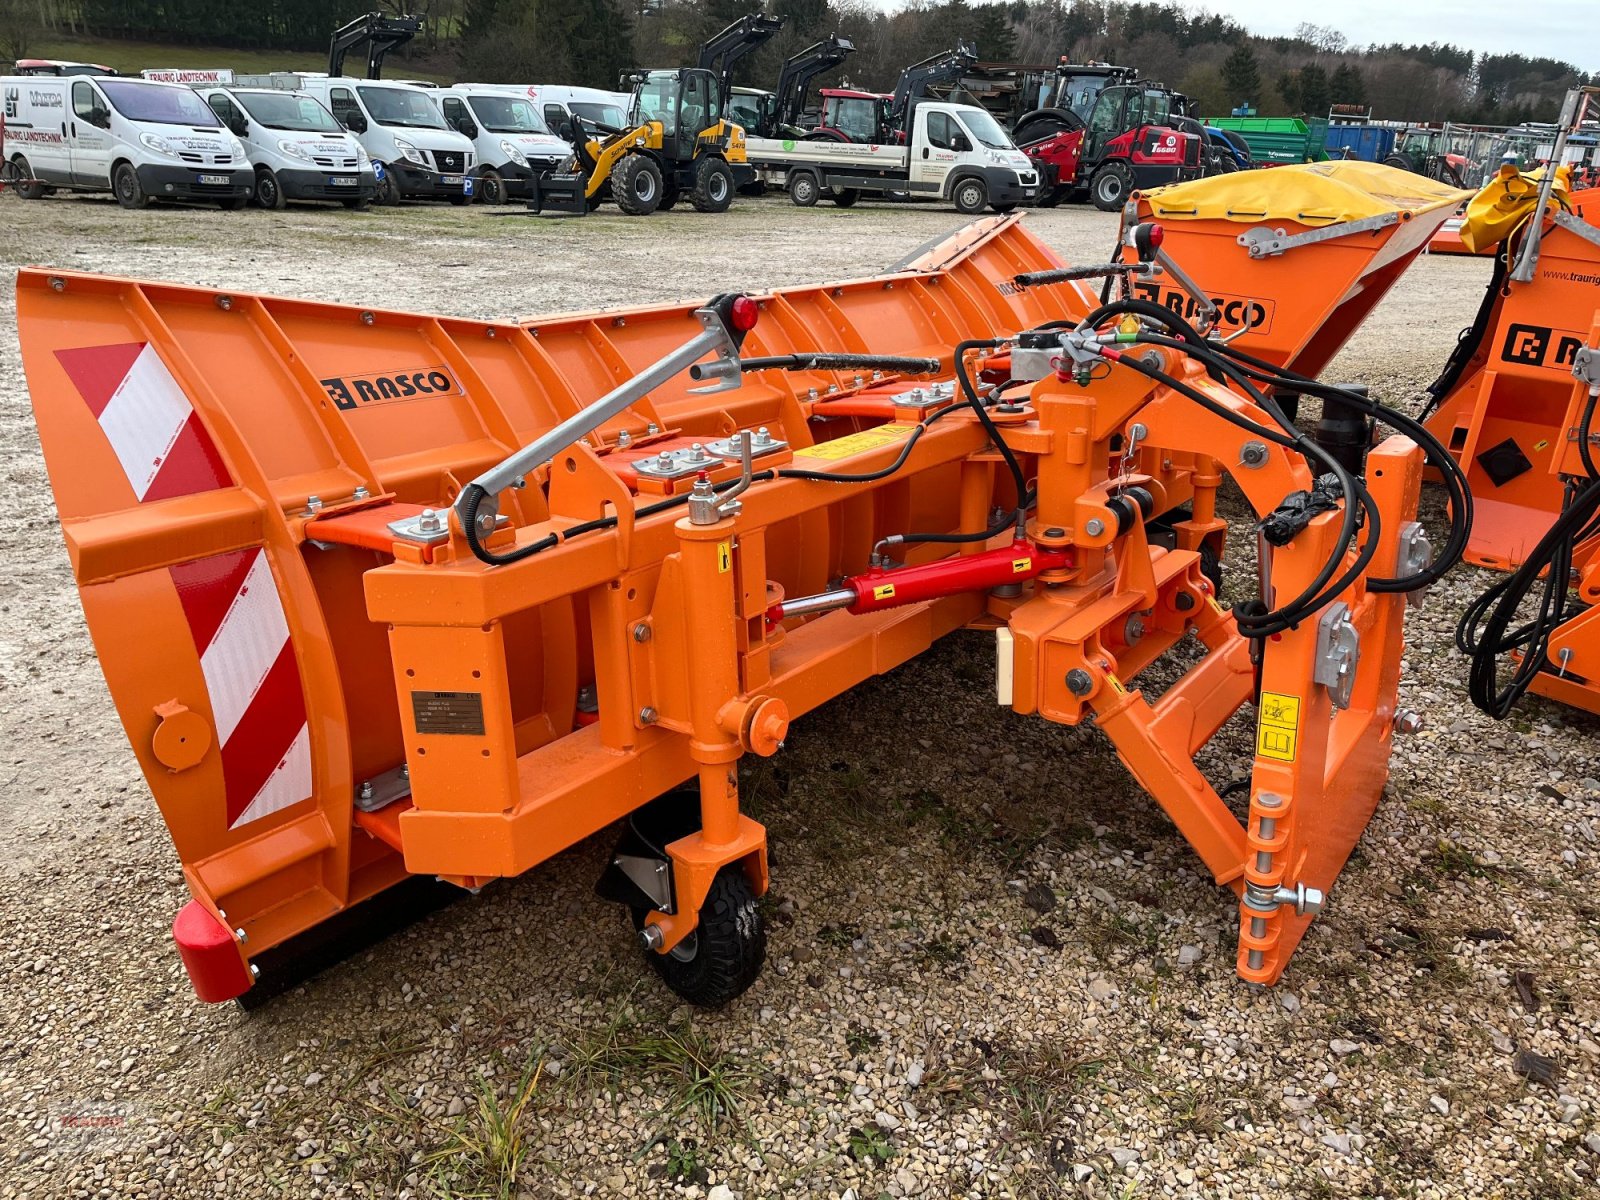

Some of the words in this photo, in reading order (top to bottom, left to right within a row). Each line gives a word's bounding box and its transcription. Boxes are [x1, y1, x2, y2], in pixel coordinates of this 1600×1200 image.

[149, 73, 174, 82] TRAURIG
[176, 72, 218, 82] LANDTECHNIK
[4, 128, 23, 140] RAURIG
[24, 131, 62, 143] LANDTECHNIK
[374, 164, 382, 177] P
[465, 180, 472, 192] P
[352, 371, 451, 402] RASCO
